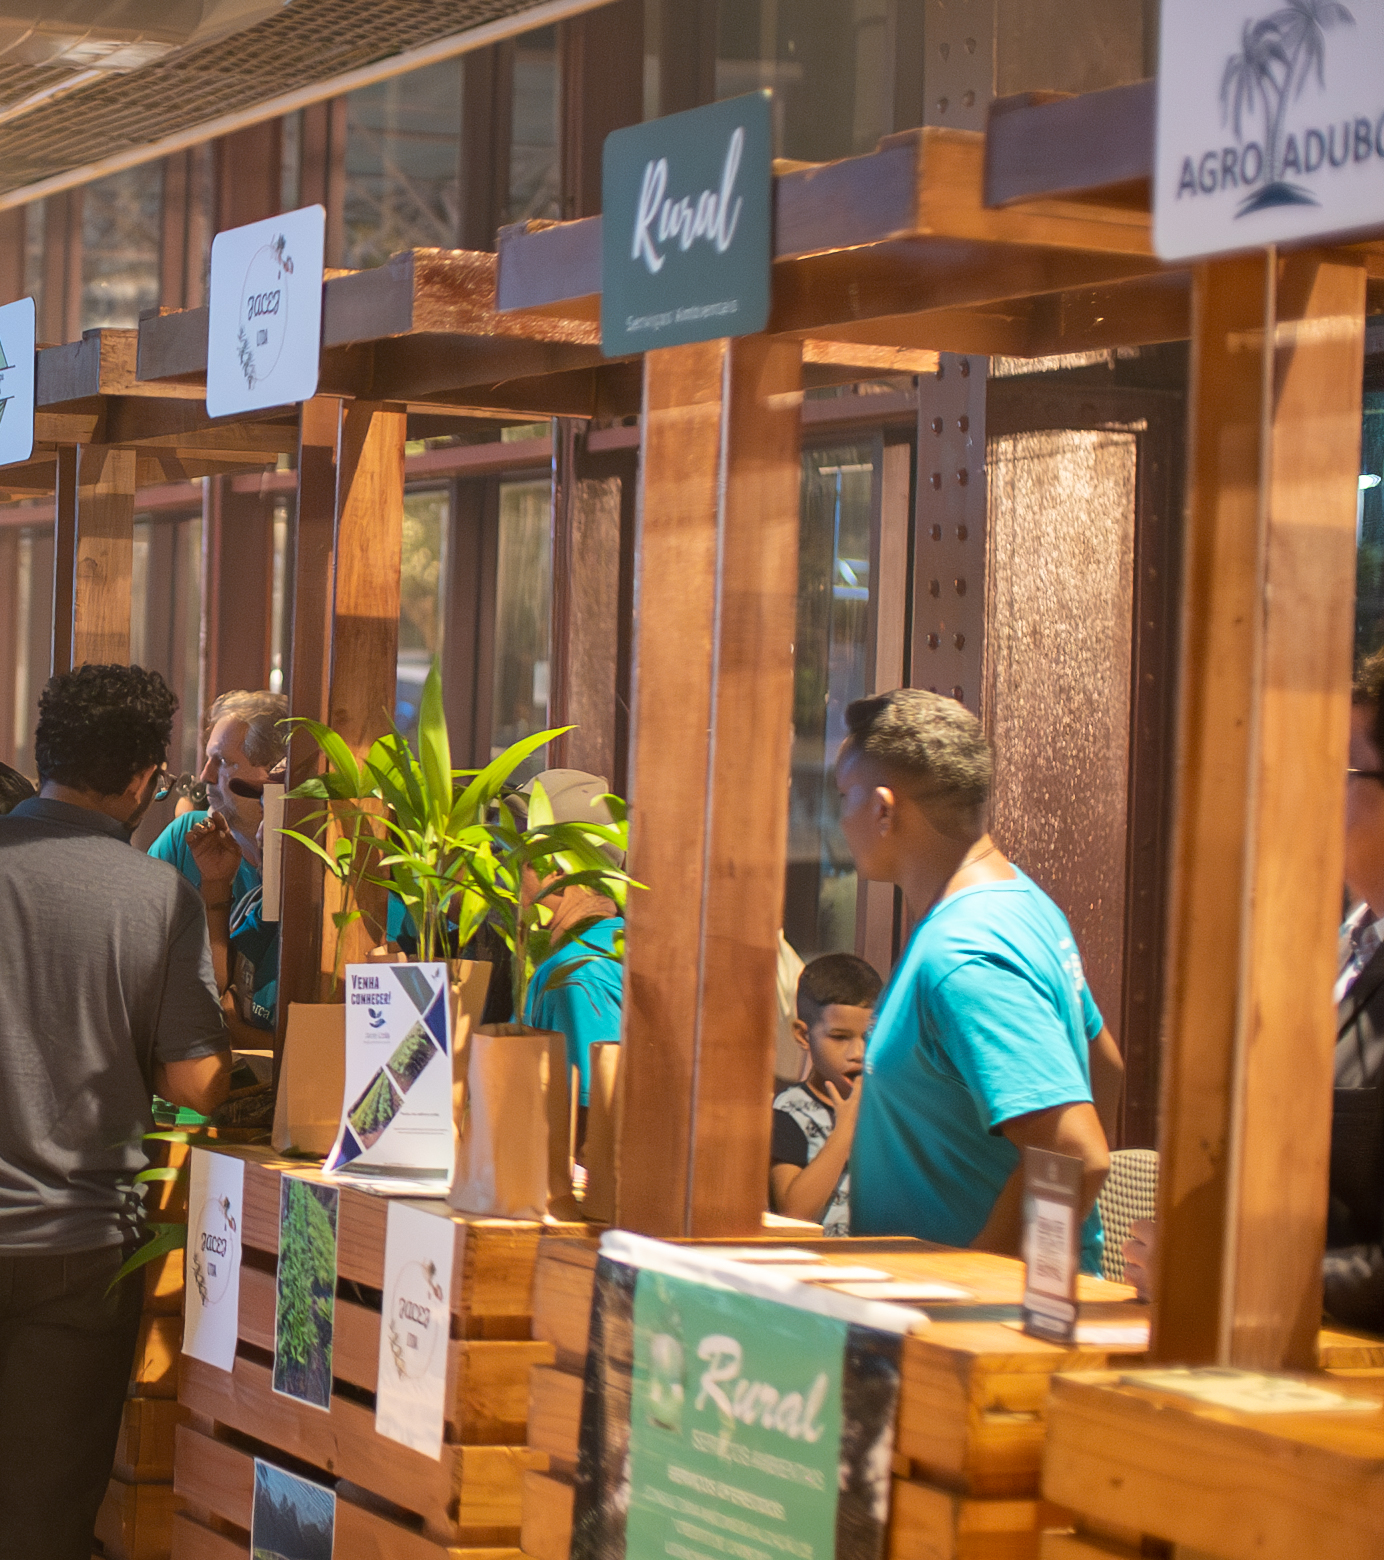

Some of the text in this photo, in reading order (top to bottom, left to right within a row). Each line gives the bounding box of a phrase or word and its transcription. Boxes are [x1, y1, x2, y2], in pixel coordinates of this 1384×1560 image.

[632, 126, 745, 274] Rural
[1176, 142, 1264, 200] AGRO
[696, 1334, 829, 1443] Rural
